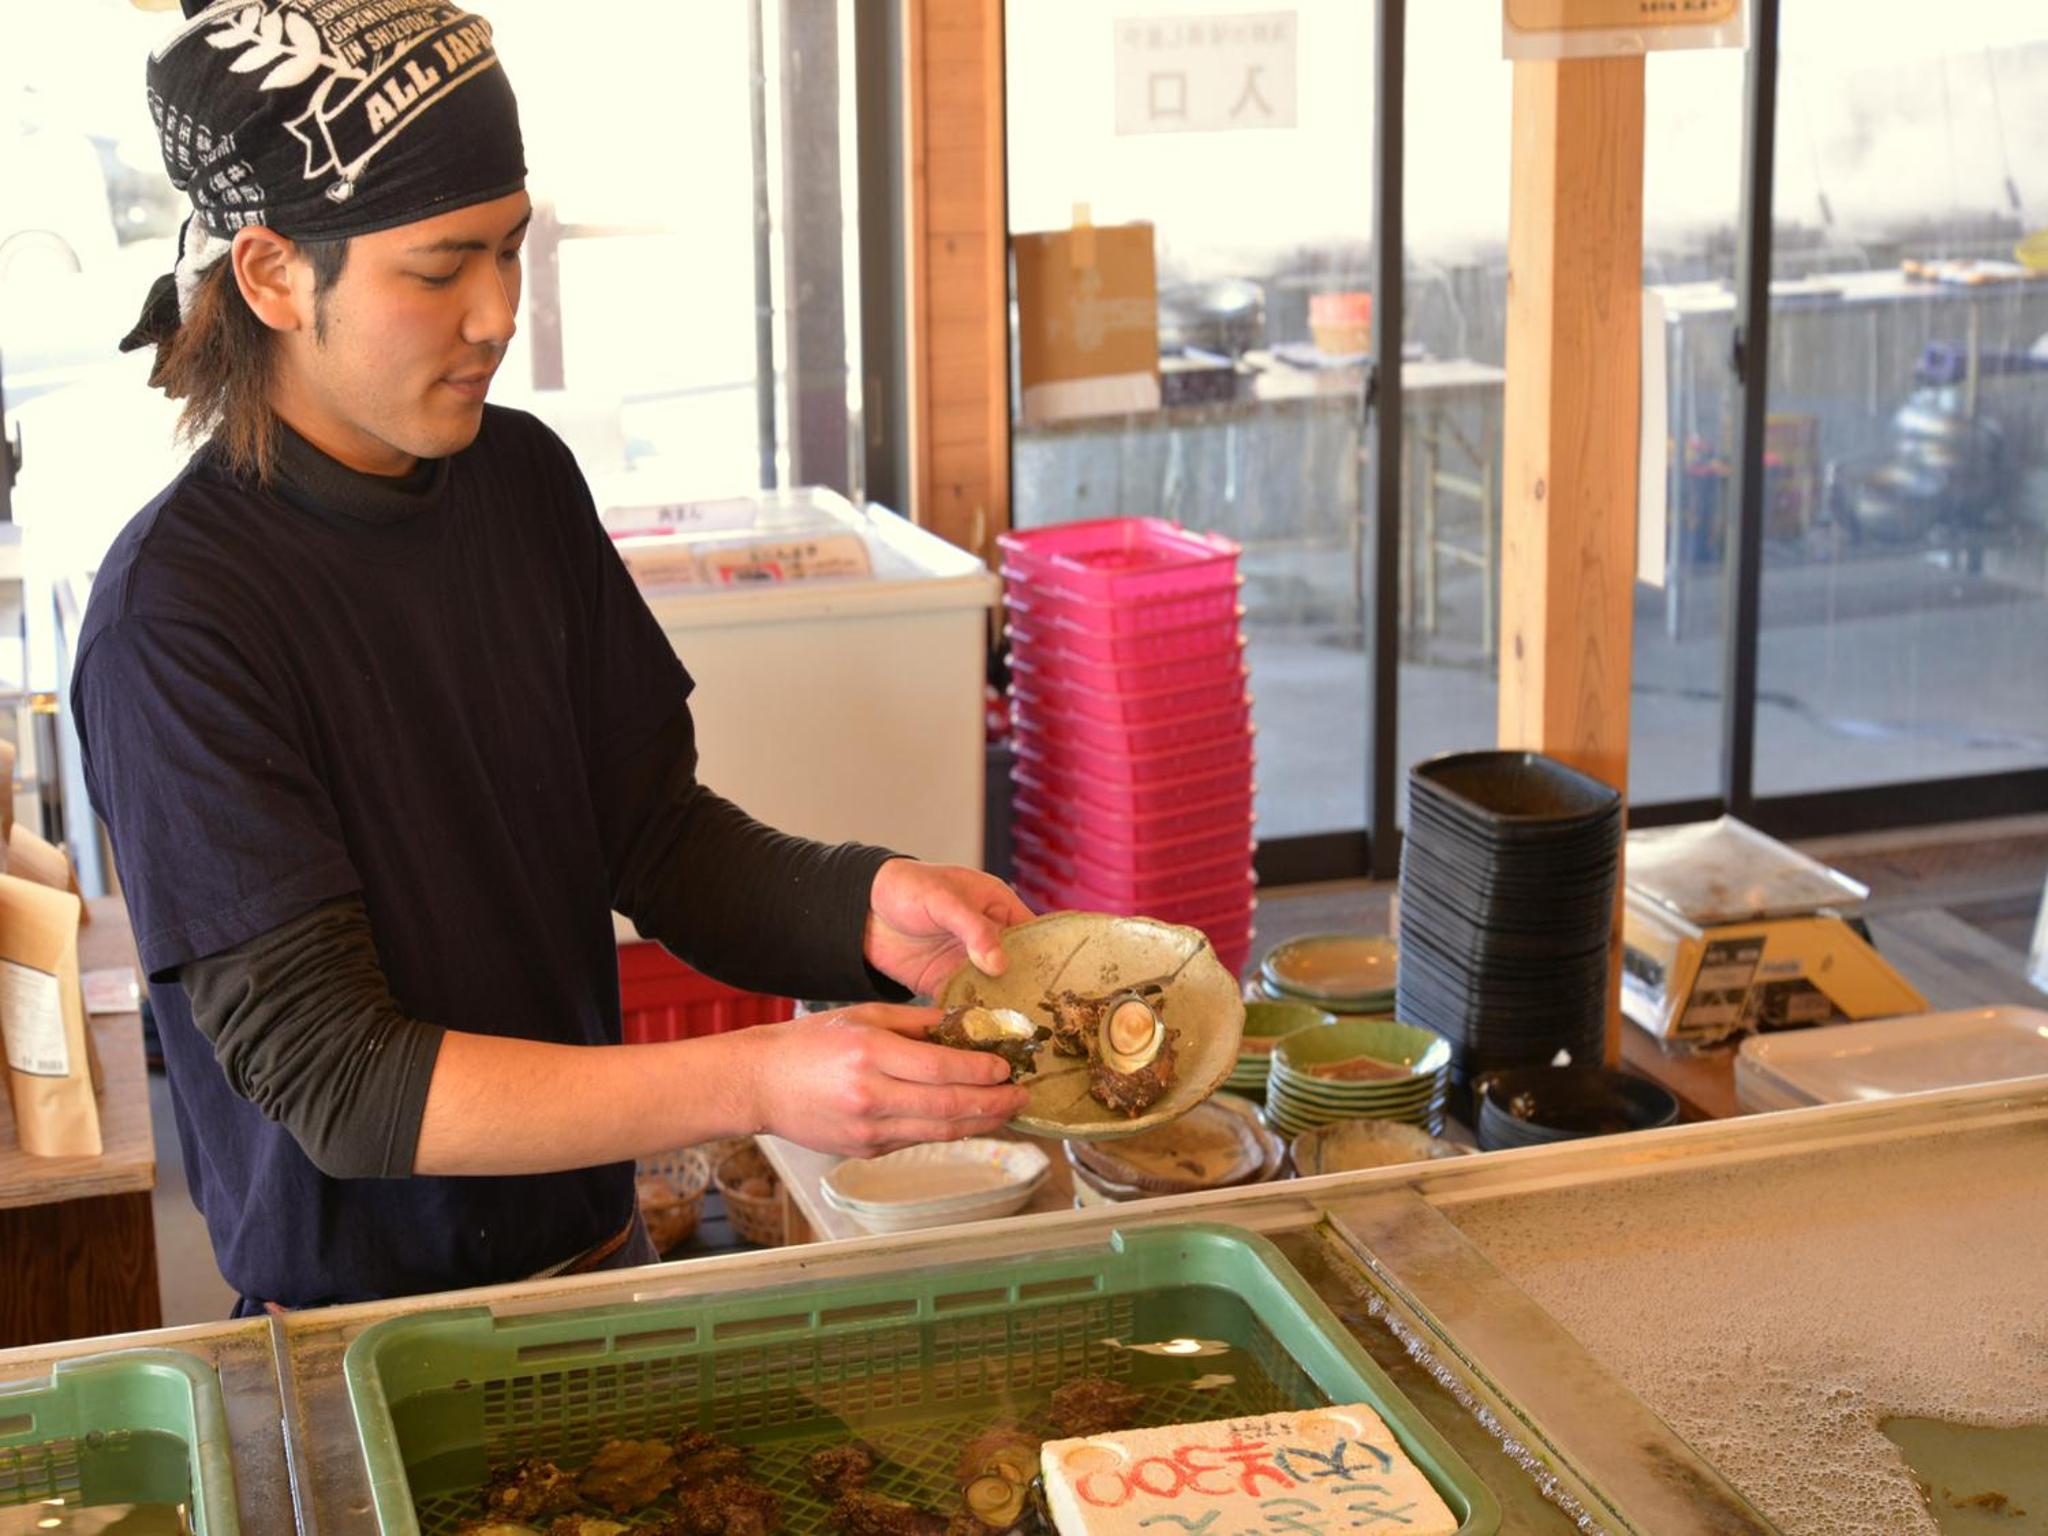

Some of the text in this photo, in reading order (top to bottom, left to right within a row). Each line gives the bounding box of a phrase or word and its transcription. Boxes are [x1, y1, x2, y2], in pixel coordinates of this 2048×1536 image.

[340, 40, 367, 68] IN
[365, 59, 442, 135] ALL
[1076, 1432, 1297, 1508] ¥300
